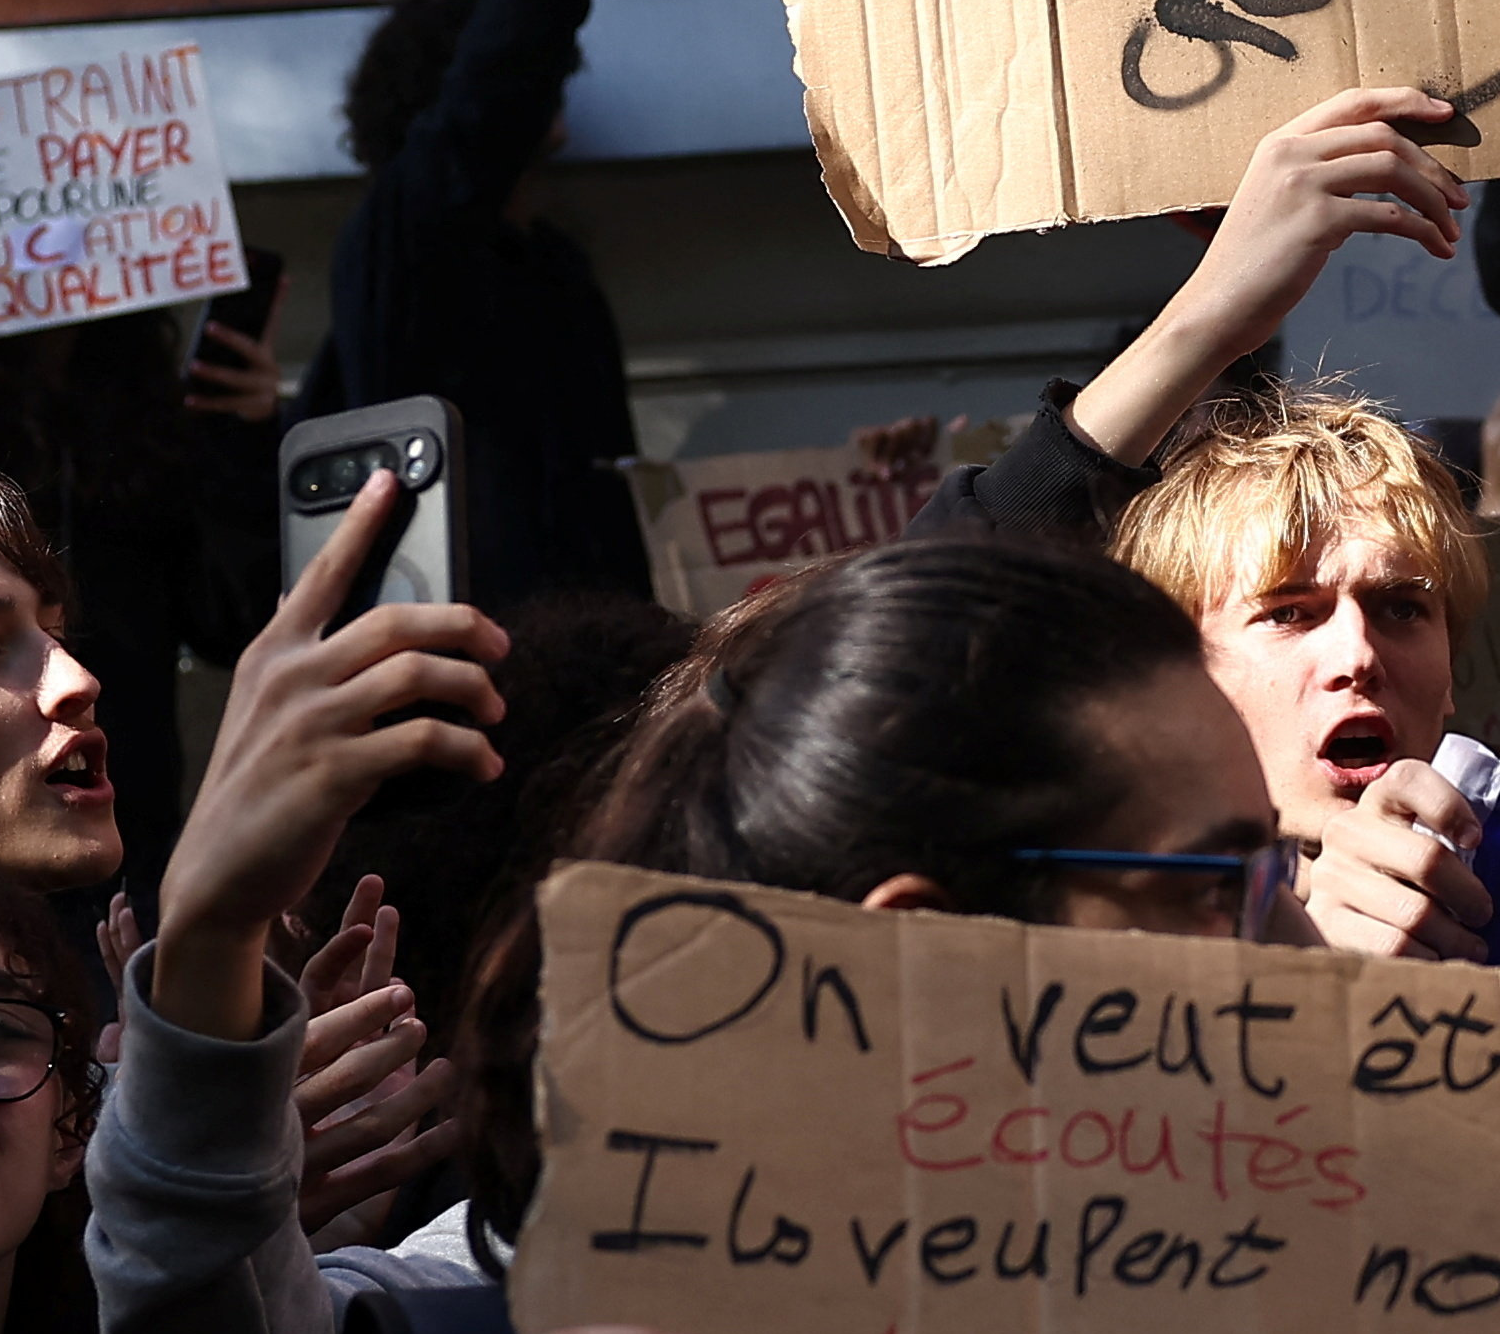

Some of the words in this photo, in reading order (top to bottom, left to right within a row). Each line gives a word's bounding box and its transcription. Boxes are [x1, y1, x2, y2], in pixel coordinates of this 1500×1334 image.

[37, 118, 194, 184] PAYER
[89, 175, 163, 212] UNE
[610, 888, 873, 1055] On
[999, 981, 1297, 1099] veut
[591, 1129, 812, 1263] Ils
[897, 1056, 1368, 1211] écoutés
